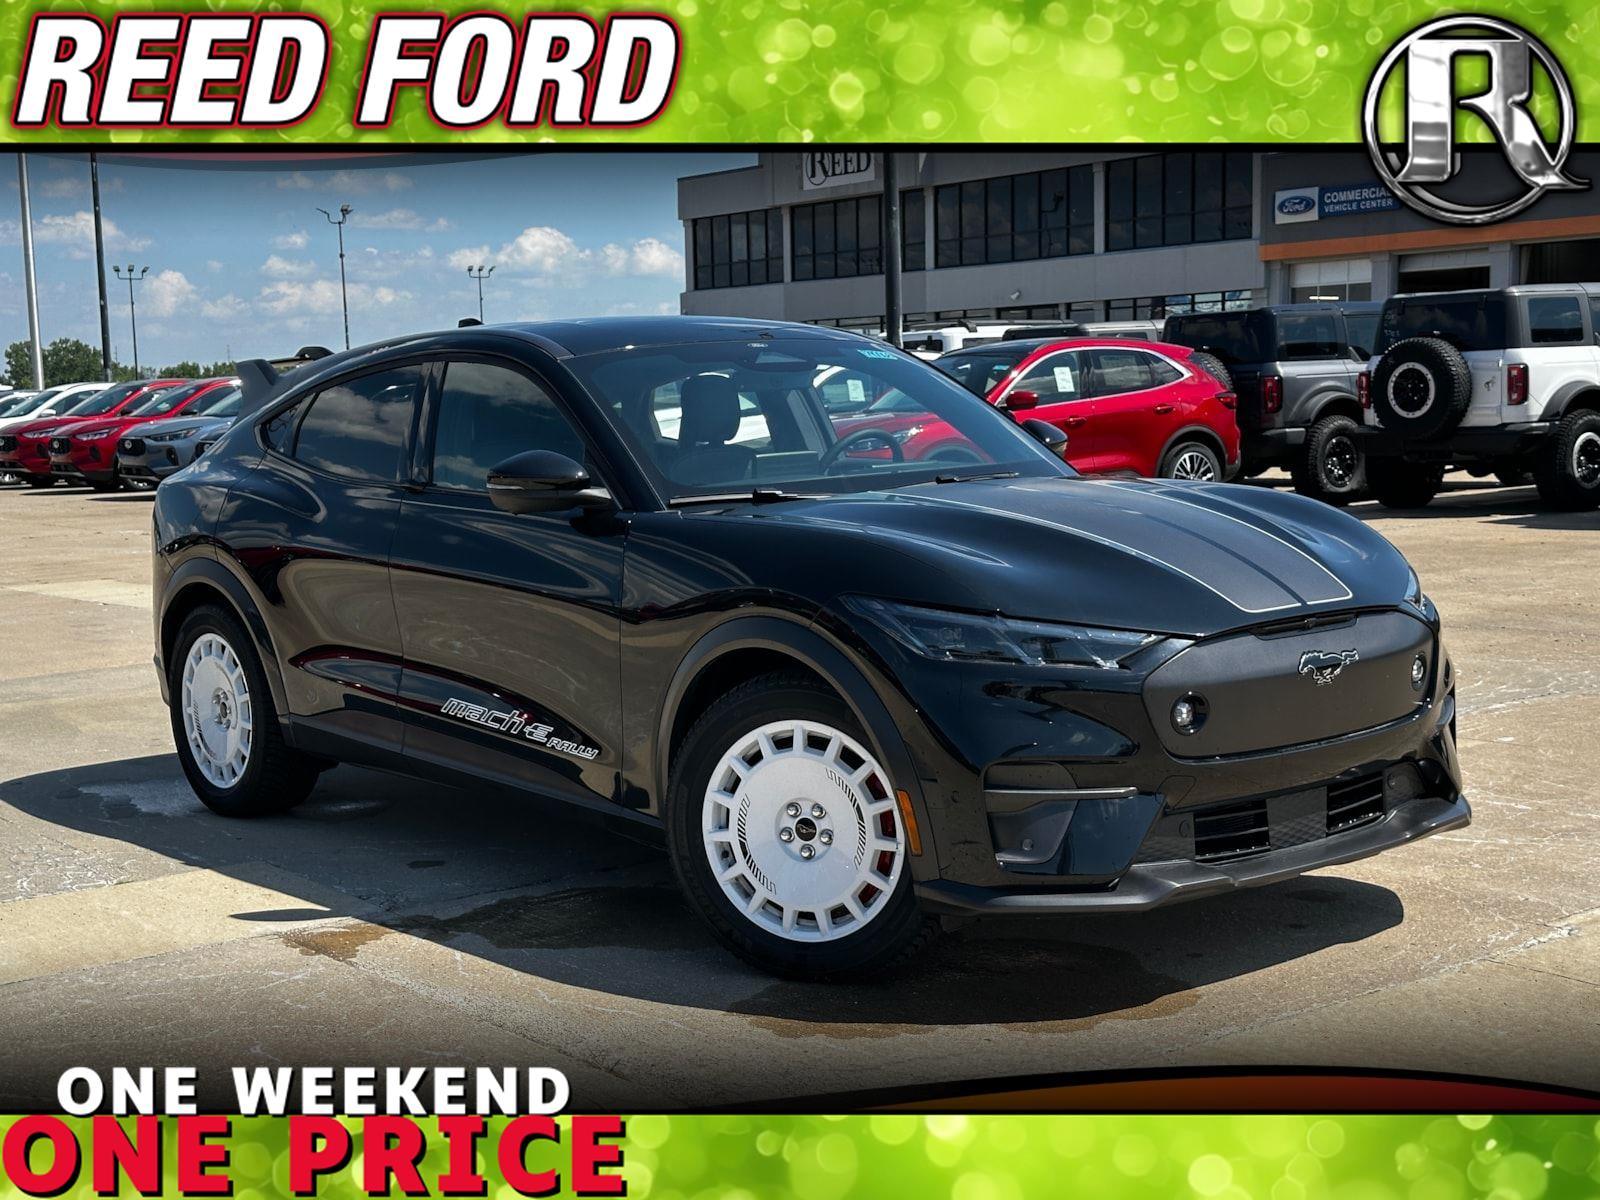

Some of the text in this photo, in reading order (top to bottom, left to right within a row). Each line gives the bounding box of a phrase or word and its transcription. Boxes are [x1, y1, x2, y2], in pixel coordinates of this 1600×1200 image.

[807, 152, 871, 179] REED
[1282, 199, 1307, 213] Ford
[1323, 198, 1393, 213] VEHICLE CENTER
[546, 737, 599, 760] RALLY
